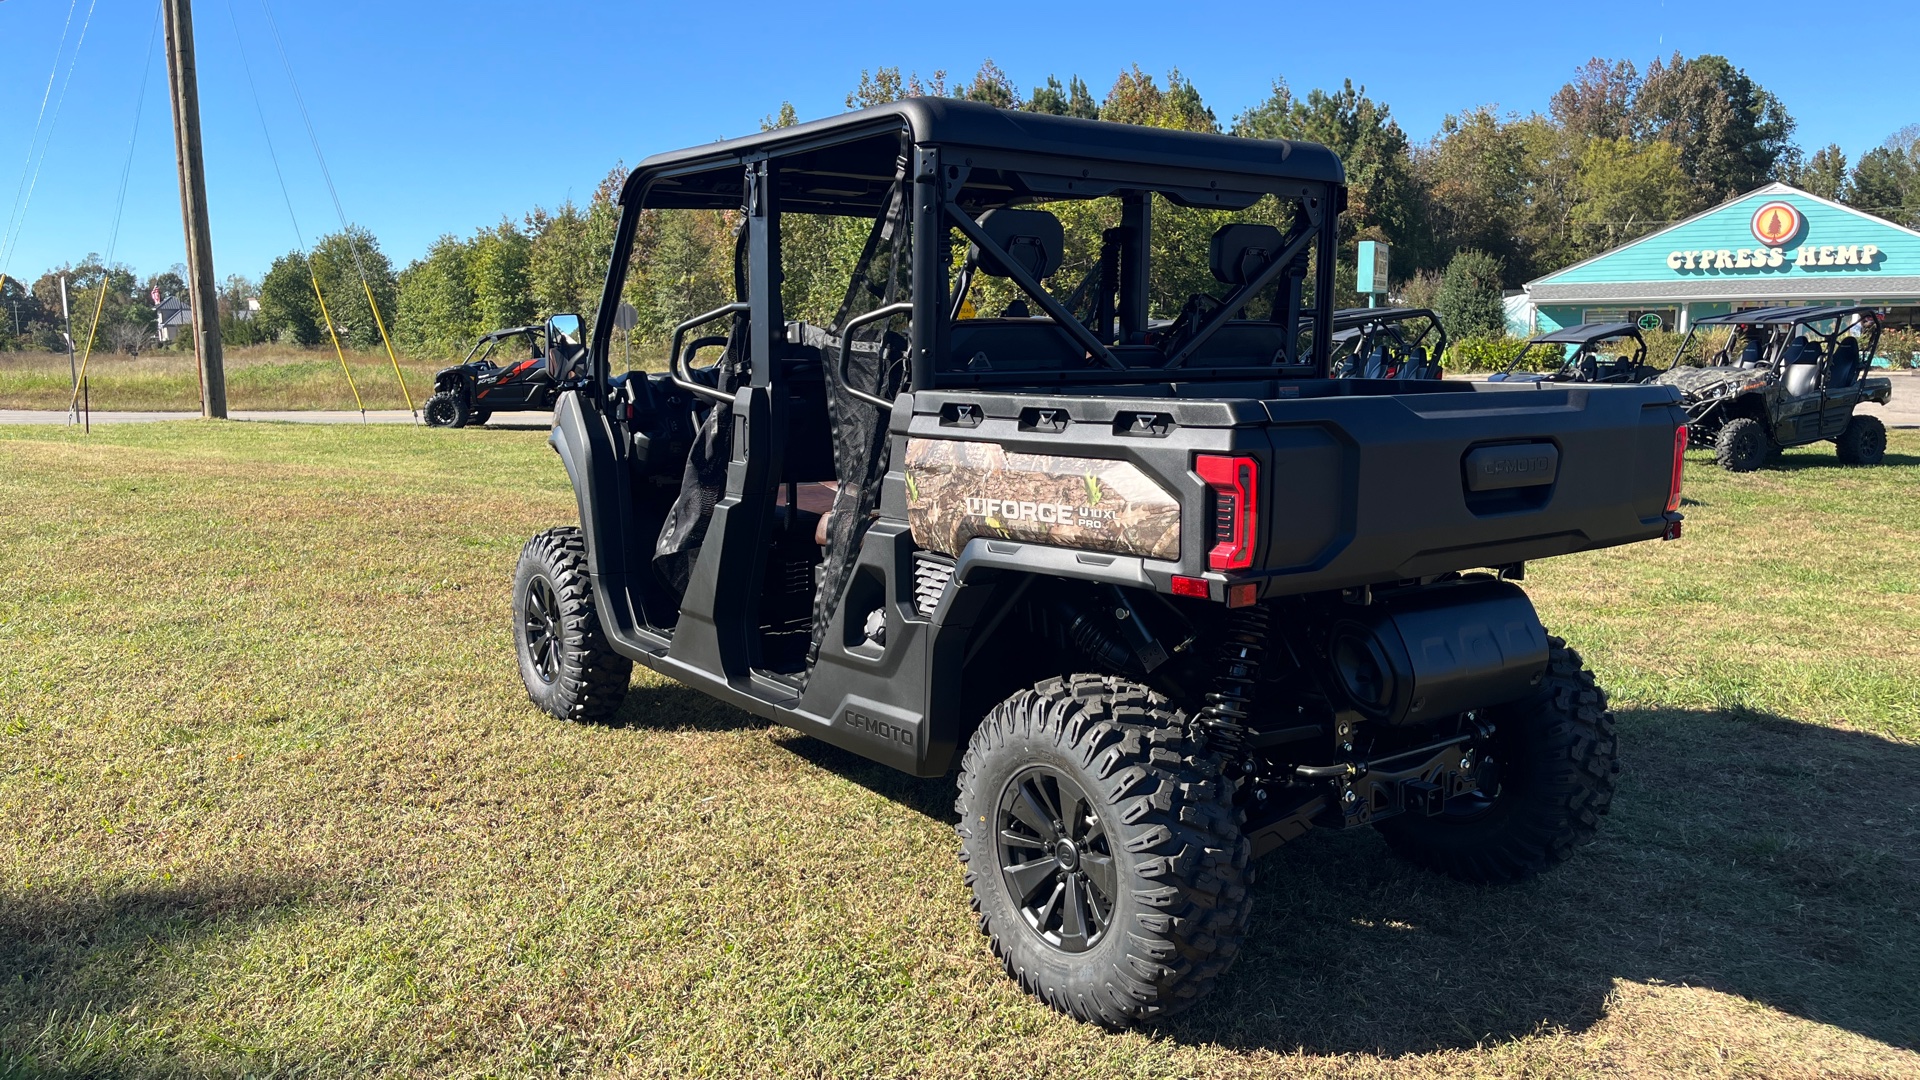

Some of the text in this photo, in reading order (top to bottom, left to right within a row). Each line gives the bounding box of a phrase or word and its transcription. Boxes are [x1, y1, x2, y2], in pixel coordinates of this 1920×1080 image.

[1666, 245, 1878, 270] CYPRESS HEMP
[1484, 457, 1549, 474] CFMOTO
[1078, 518, 1102, 529] PRO
[844, 709, 914, 747] CFMOTO
